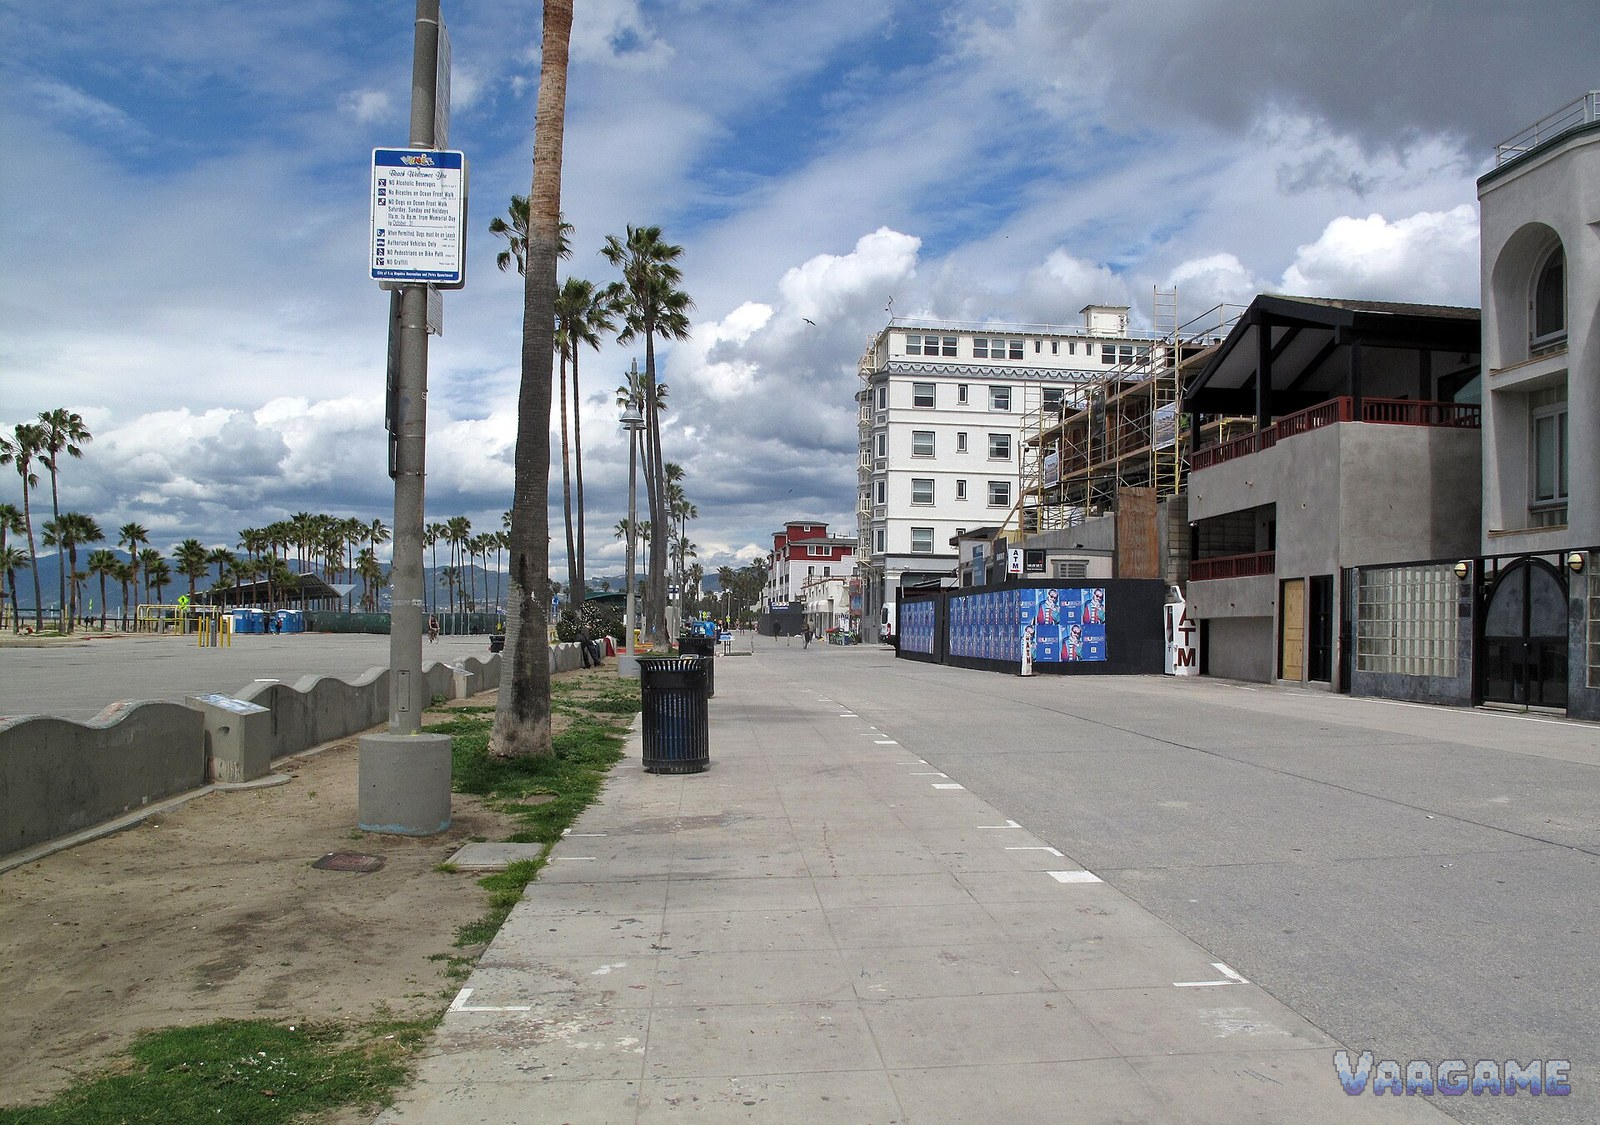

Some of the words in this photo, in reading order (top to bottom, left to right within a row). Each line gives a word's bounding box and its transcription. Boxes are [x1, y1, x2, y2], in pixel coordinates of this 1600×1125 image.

[389, 169, 405, 177] Beach
[407, 170, 433, 178] Welcomes
[435, 171, 447, 181] You
[1178, 606, 1197, 667] ATM
